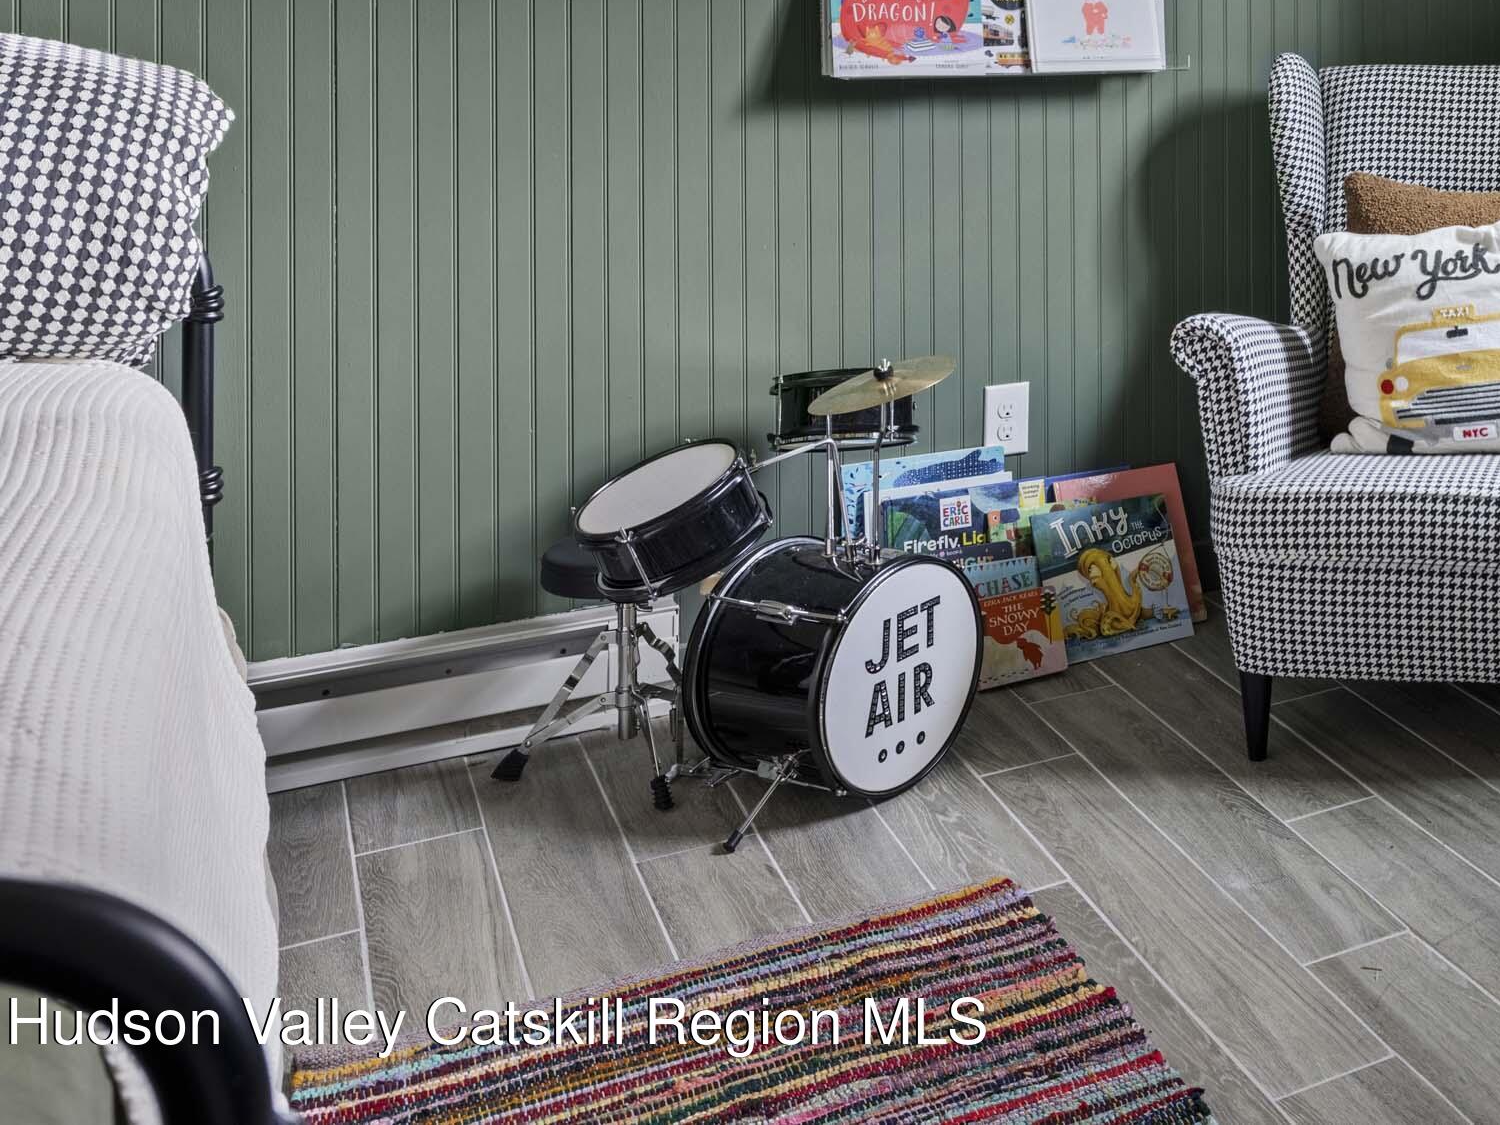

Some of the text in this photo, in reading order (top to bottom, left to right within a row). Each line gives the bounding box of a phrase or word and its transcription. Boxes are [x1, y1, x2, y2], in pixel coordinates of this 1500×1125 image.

[852, 1, 937, 27] DRAGON!
[1440, 306, 1469, 317] TAXI
[1461, 426, 1490, 440] NYC
[942, 504, 969, 518] ERIC
[942, 514, 970, 528] CARLE
[1049, 506, 1128, 559] Inky
[975, 571, 1033, 599] CHASE
[1001, 602, 1025, 613] THE
[989, 607, 1040, 628] SNOWY
[864, 594, 941, 675] JET
[1003, 620, 1030, 636] DAY
[864, 661, 936, 739] AIR
